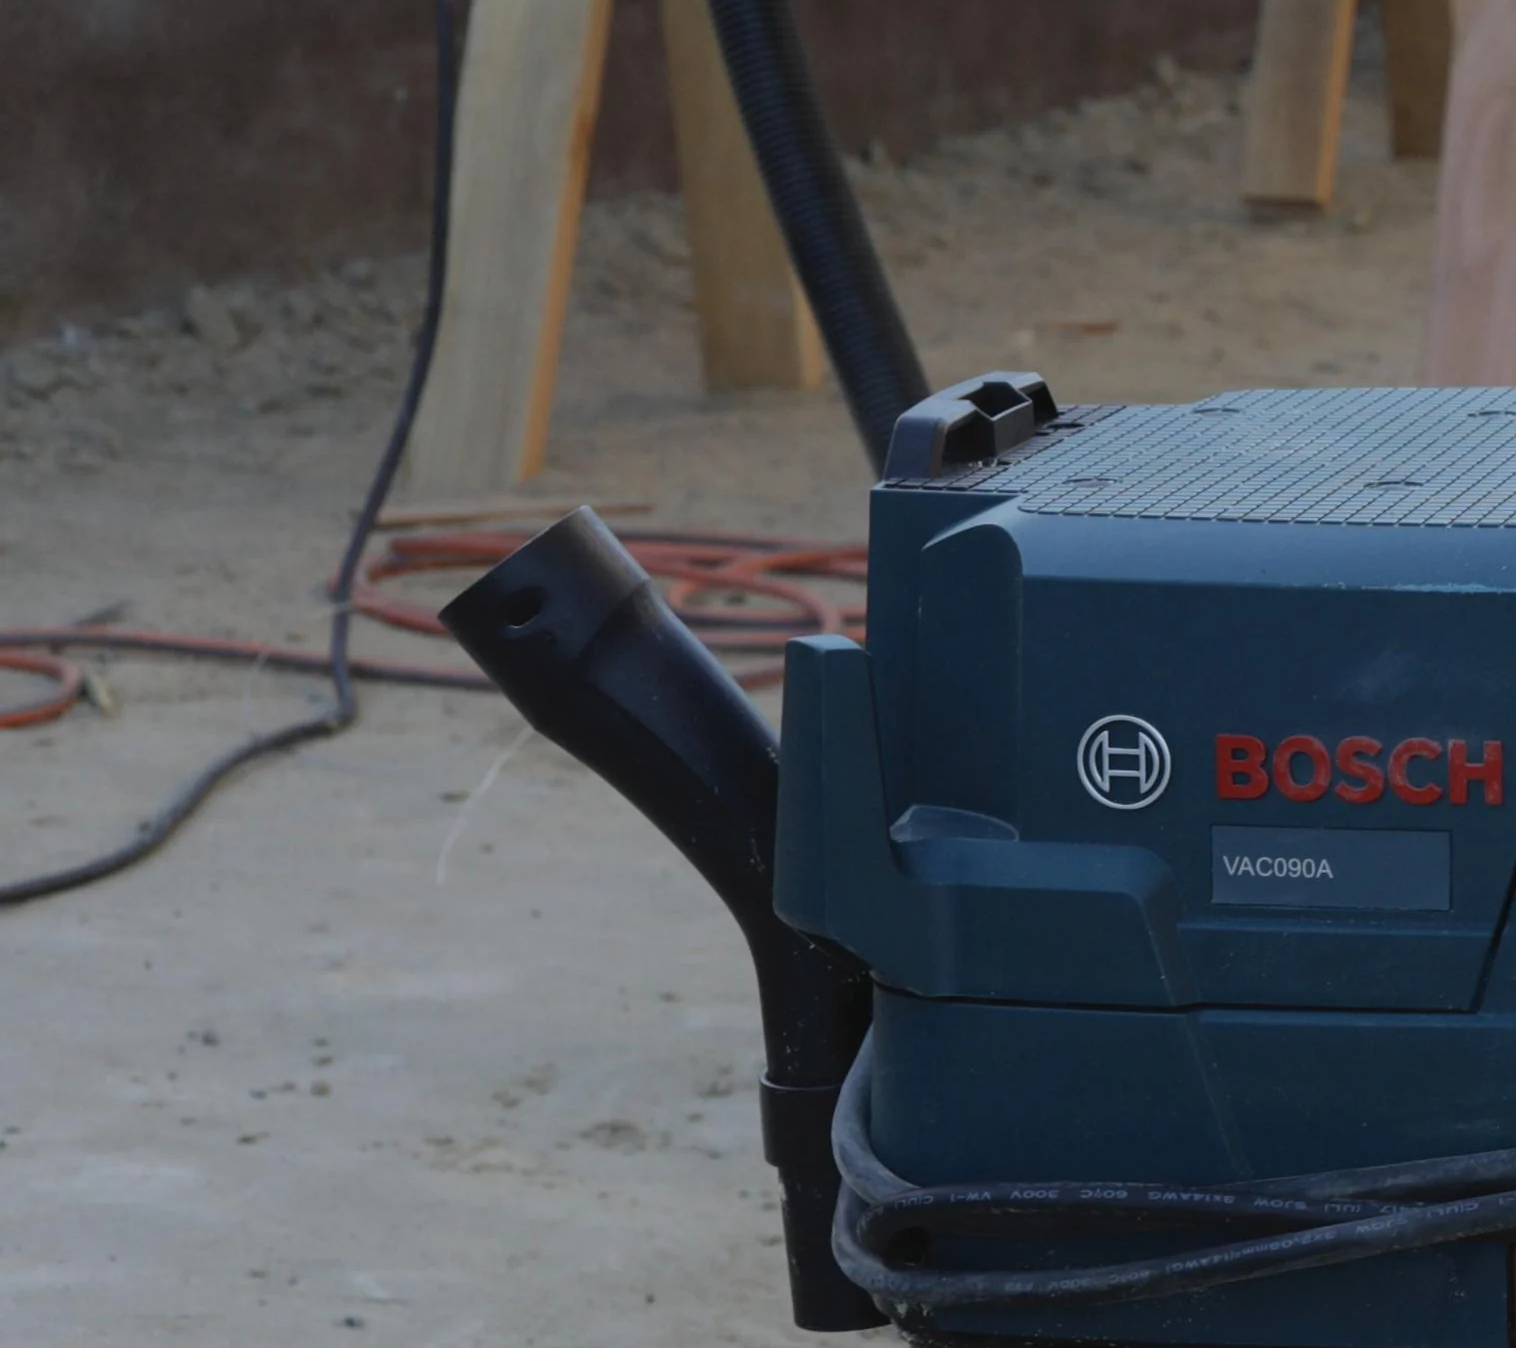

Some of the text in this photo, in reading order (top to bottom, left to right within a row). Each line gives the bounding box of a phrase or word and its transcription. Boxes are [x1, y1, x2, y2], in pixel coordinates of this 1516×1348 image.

[1214, 733, 1505, 806] BOSCH
[1223, 855, 1334, 880] VAC090A
[950, 1190, 992, 1202] VW-1
[1010, 1188, 1060, 1200] 300V
[1253, 1197, 1307, 1211] SJOW
